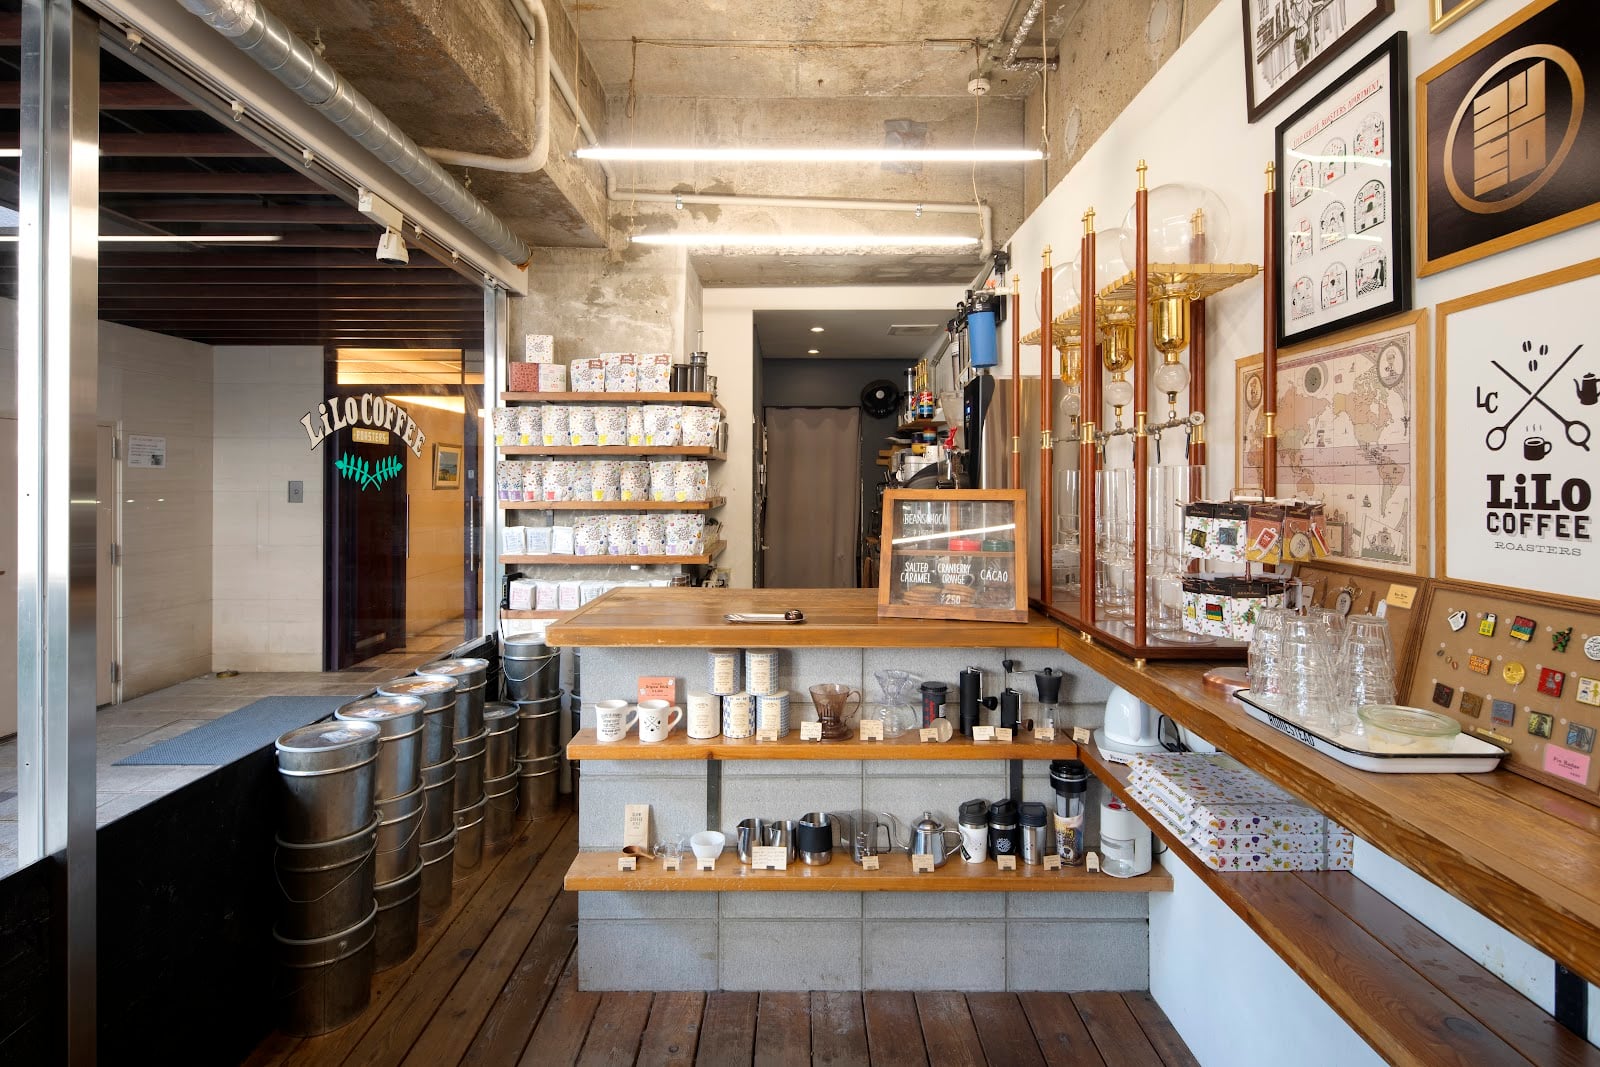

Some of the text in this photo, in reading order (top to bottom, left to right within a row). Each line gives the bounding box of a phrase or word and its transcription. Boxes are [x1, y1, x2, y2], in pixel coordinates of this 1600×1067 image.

[1348, 80, 1379, 108] APARTMENT
[361, 393, 426, 459] COFFEE
[355, 429, 387, 443] ROASTERS
[1486, 473, 1592, 512] LiLO
[1486, 512, 1593, 541] COFFEE
[1494, 541, 1582, 557] ROASTERS
[904, 561, 929, 573] SALTED
[937, 562, 972, 575] CRANBERRY
[900, 572, 932, 584] CARAMEL
[941, 573, 966, 585] ORANGE
[980, 569, 1008, 583] CACAO
